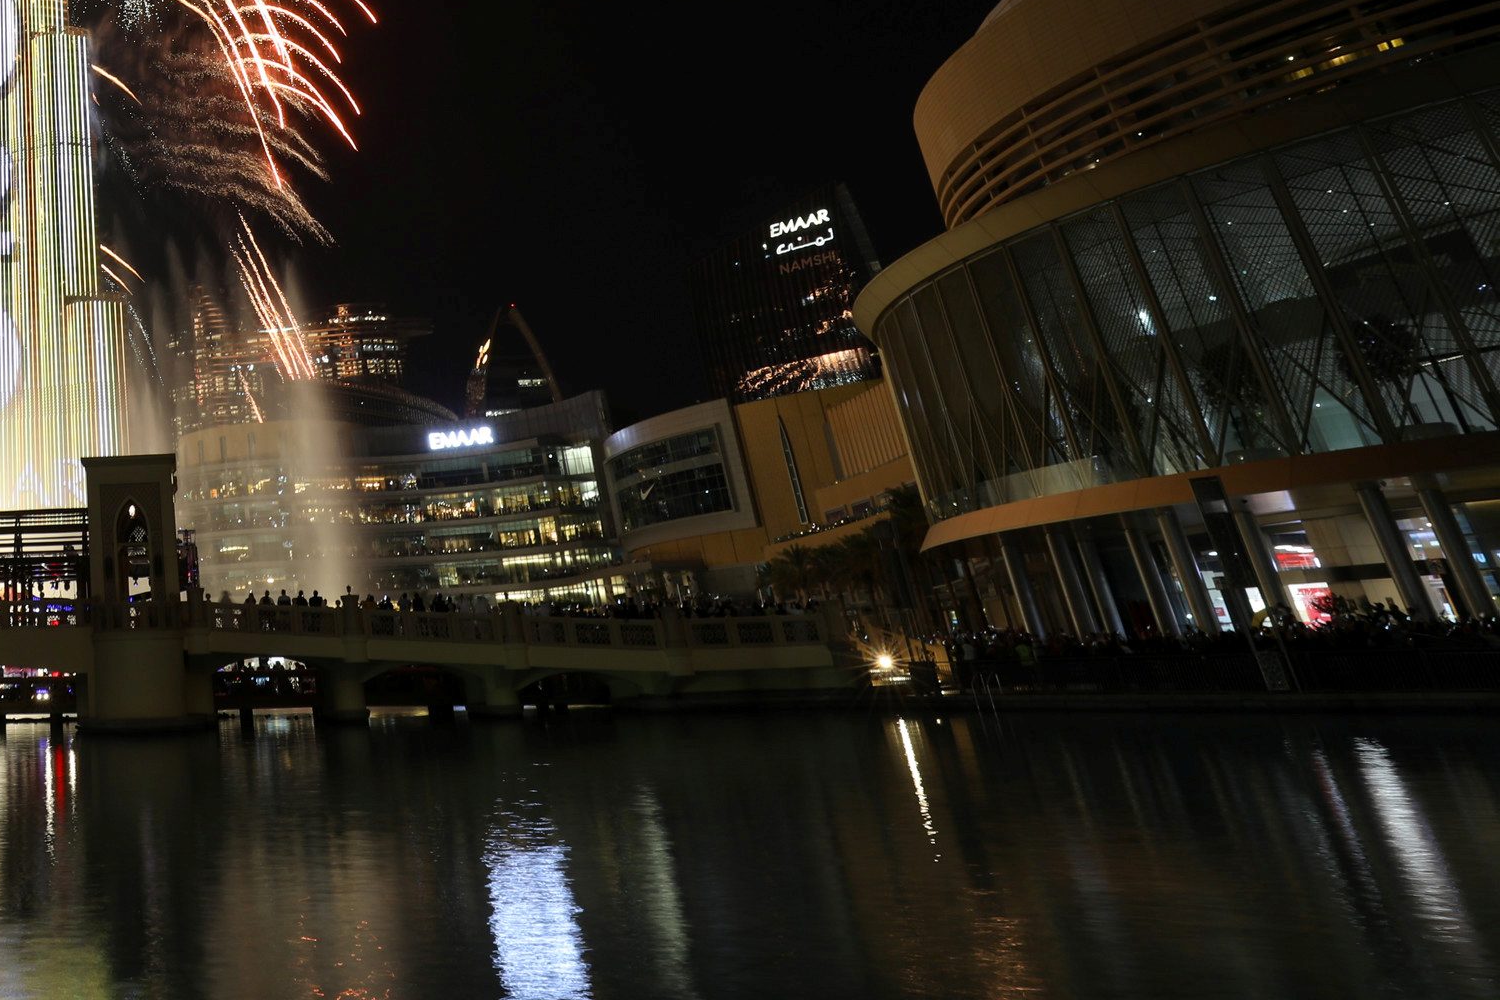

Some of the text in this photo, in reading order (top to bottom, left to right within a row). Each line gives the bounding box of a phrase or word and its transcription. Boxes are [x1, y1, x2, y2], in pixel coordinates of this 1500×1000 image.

[770, 209, 830, 238] EMAAR
[780, 251, 837, 275] NAMSHI
[428, 426, 494, 450] EMAAR
